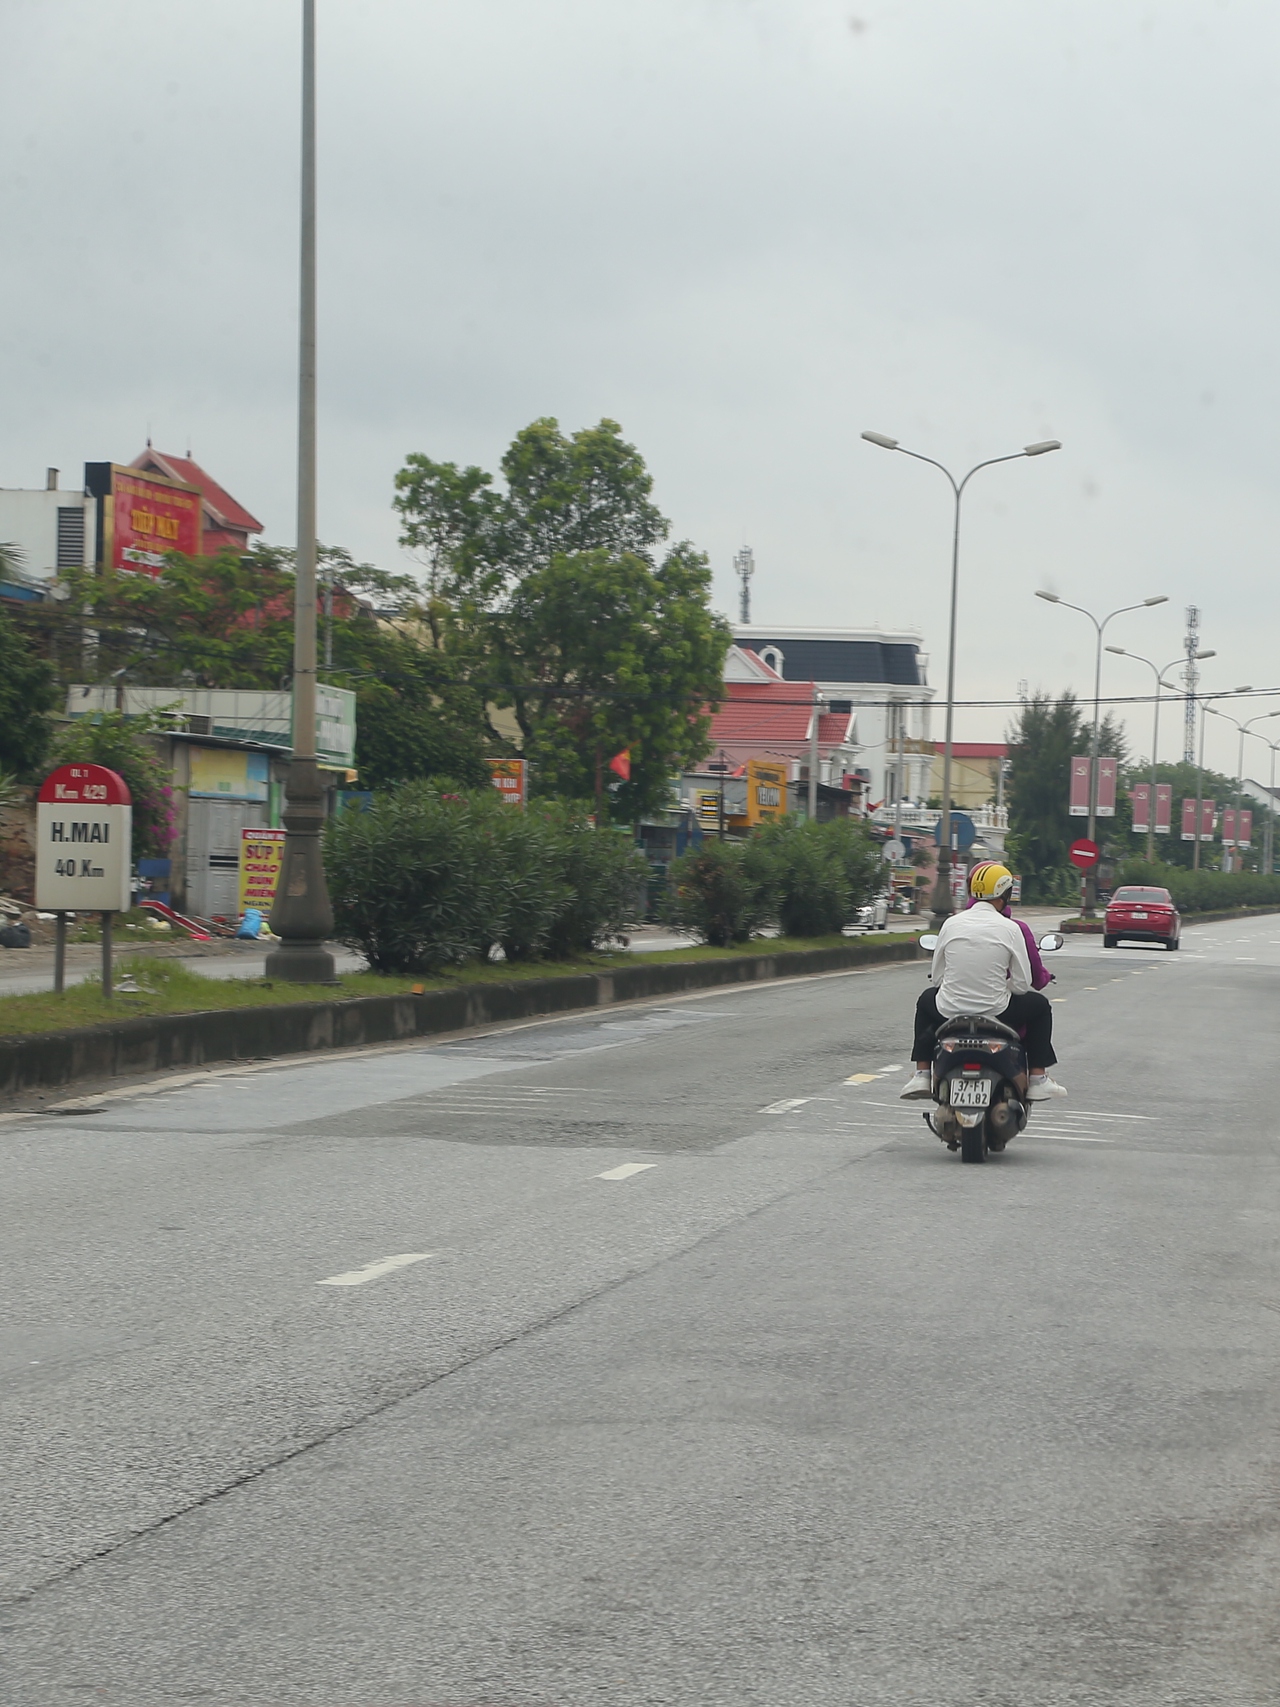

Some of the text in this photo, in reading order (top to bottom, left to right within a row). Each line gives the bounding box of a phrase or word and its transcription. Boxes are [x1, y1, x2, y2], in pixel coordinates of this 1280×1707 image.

[54, 784, 108, 800] Km 429
[51, 821, 110, 843] H.MAI
[55, 858, 76, 877] 40
[958, 1080, 985, 1092] 37-F1
[953, 1092, 988, 1105] 741.82
